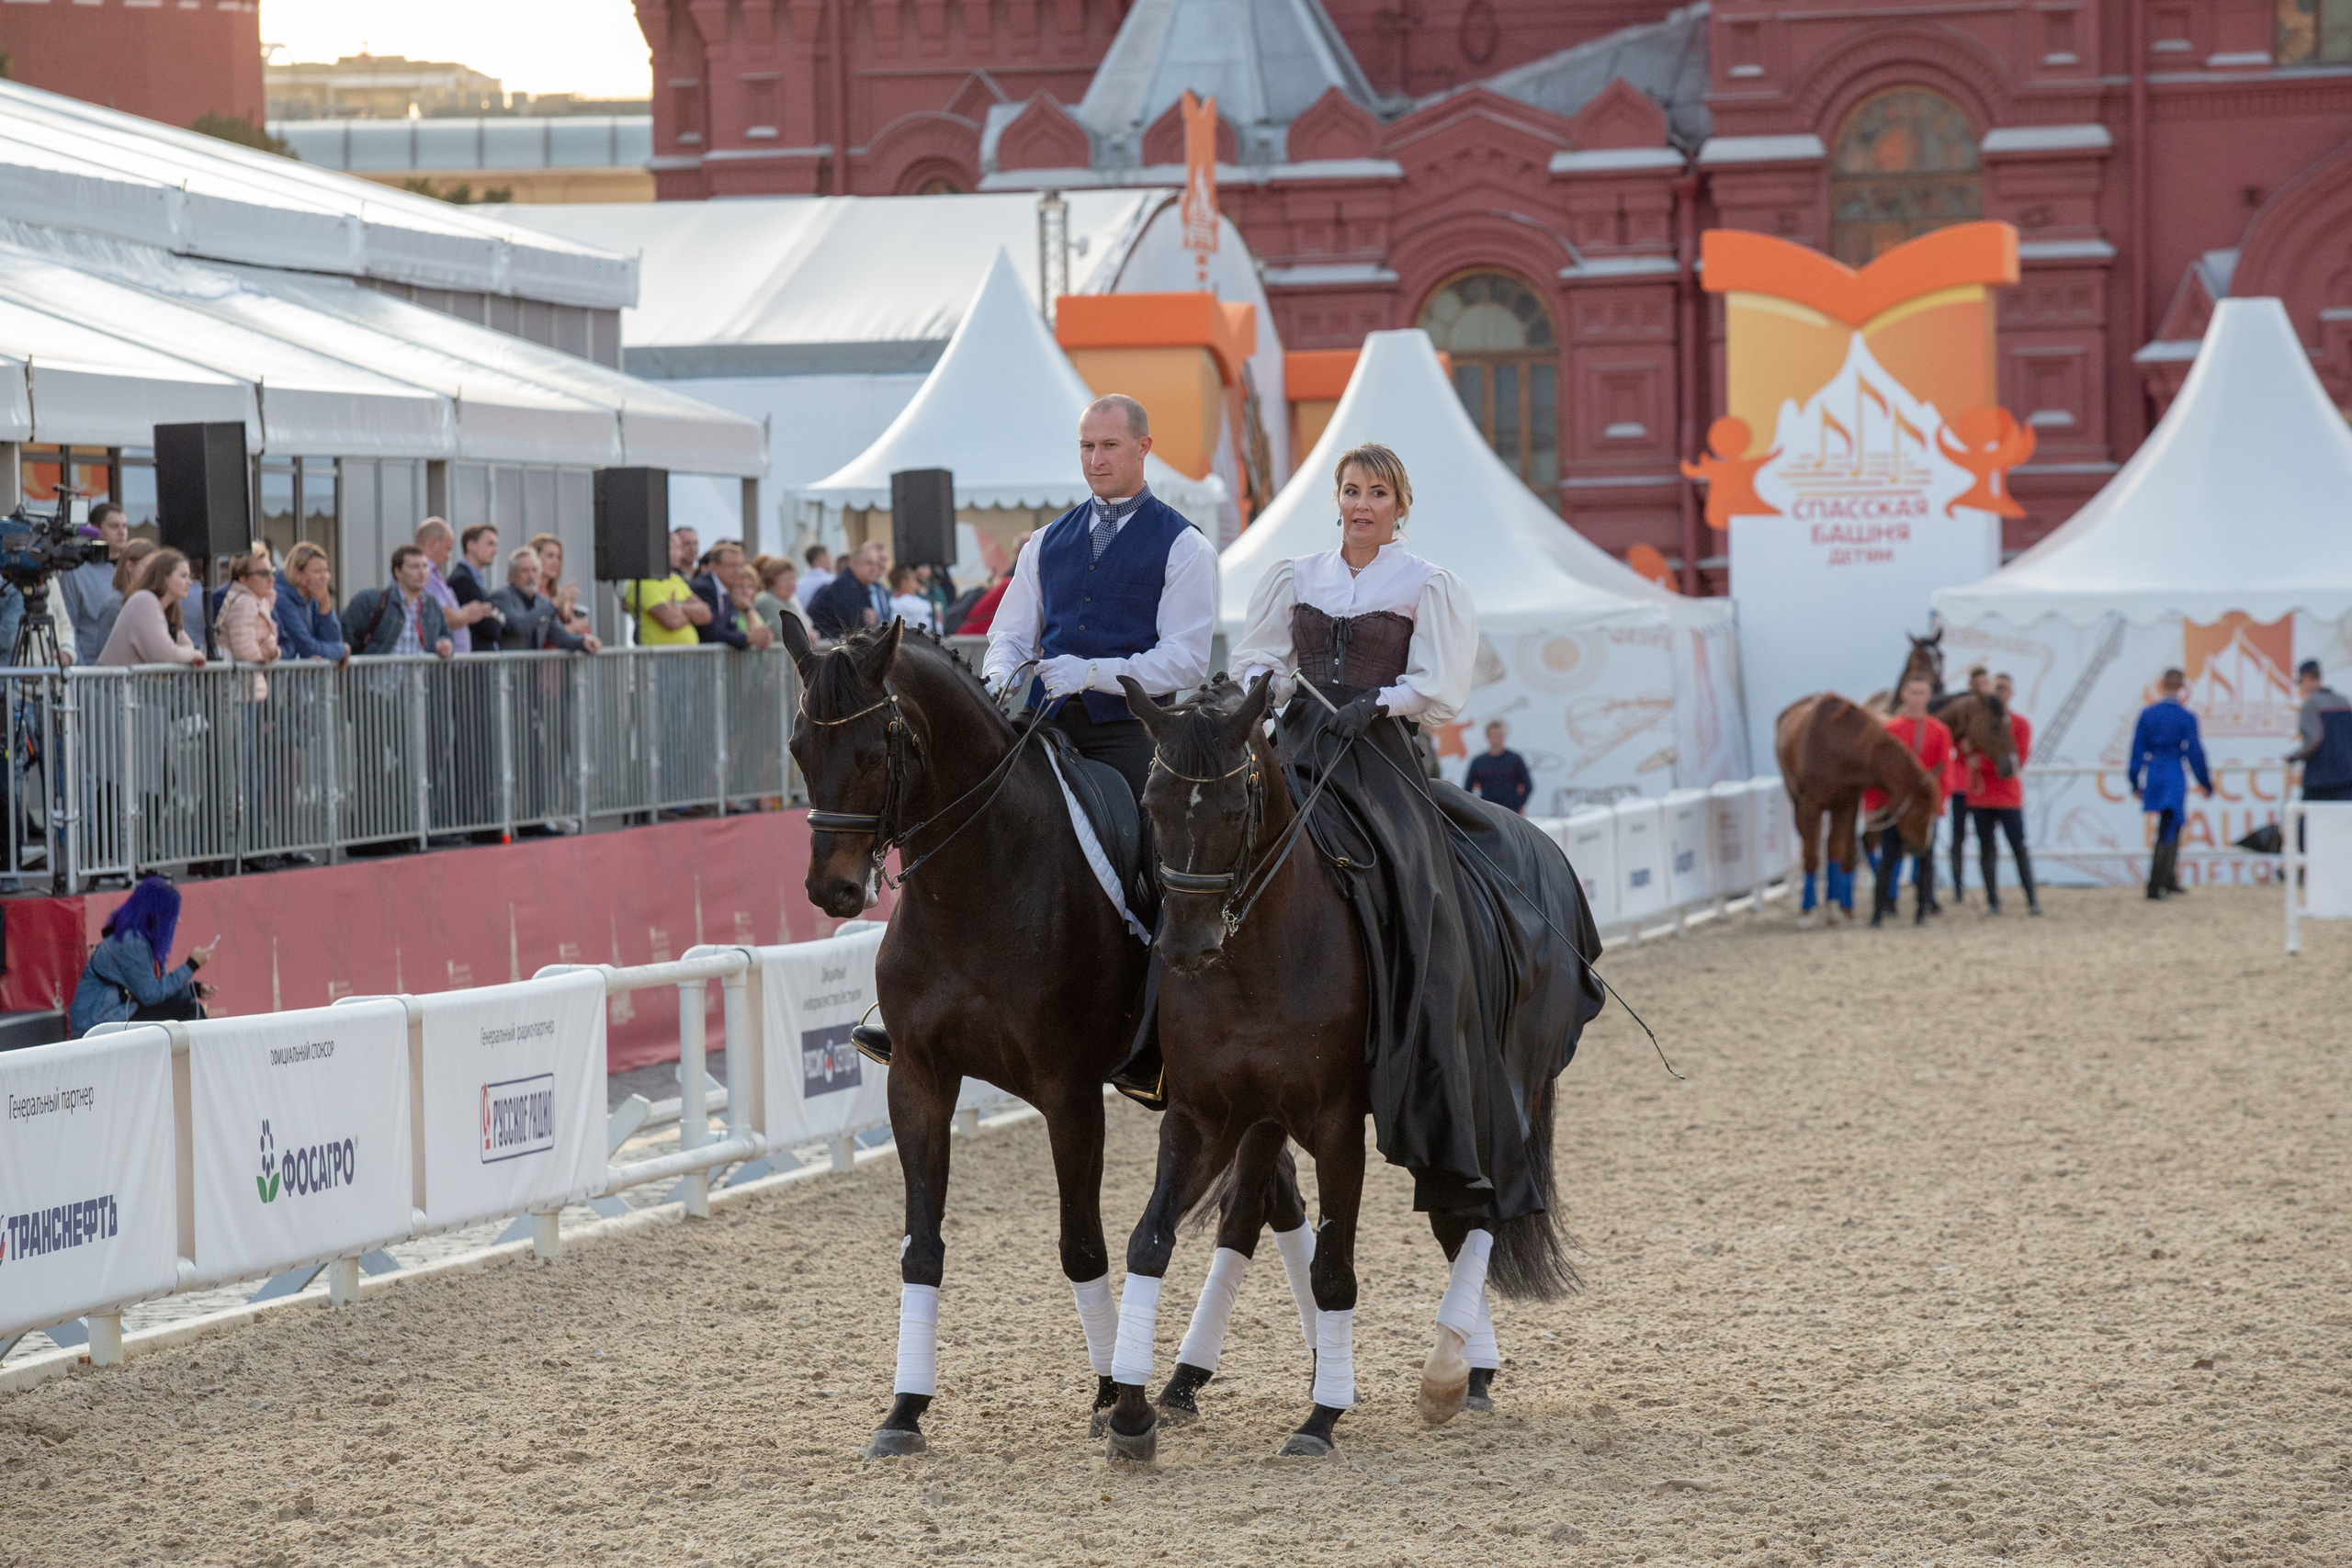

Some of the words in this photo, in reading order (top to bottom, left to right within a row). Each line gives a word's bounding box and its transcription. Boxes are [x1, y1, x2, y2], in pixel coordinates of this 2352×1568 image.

[1791, 497, 1929, 521] СПАССКАЯ
[1811, 523, 1910, 545] БАШНЯ
[481, 1021, 516, 1049] Генеральный
[269, 1041, 311, 1067] ОФИЦИАЛЬНЫЙ
[311, 1040, 334, 1060] СПОНСОР
[8, 1087, 61, 1124] Генеральный
[61, 1086, 95, 1115] партнер
[493, 1094, 527, 1148] РУССКОЕ
[528, 1089, 552, 1141] РАДИО
[282, 1138, 355, 1197] ФОСАГРО
[7, 1194, 118, 1261] ТРАНСНЕФТЬ
